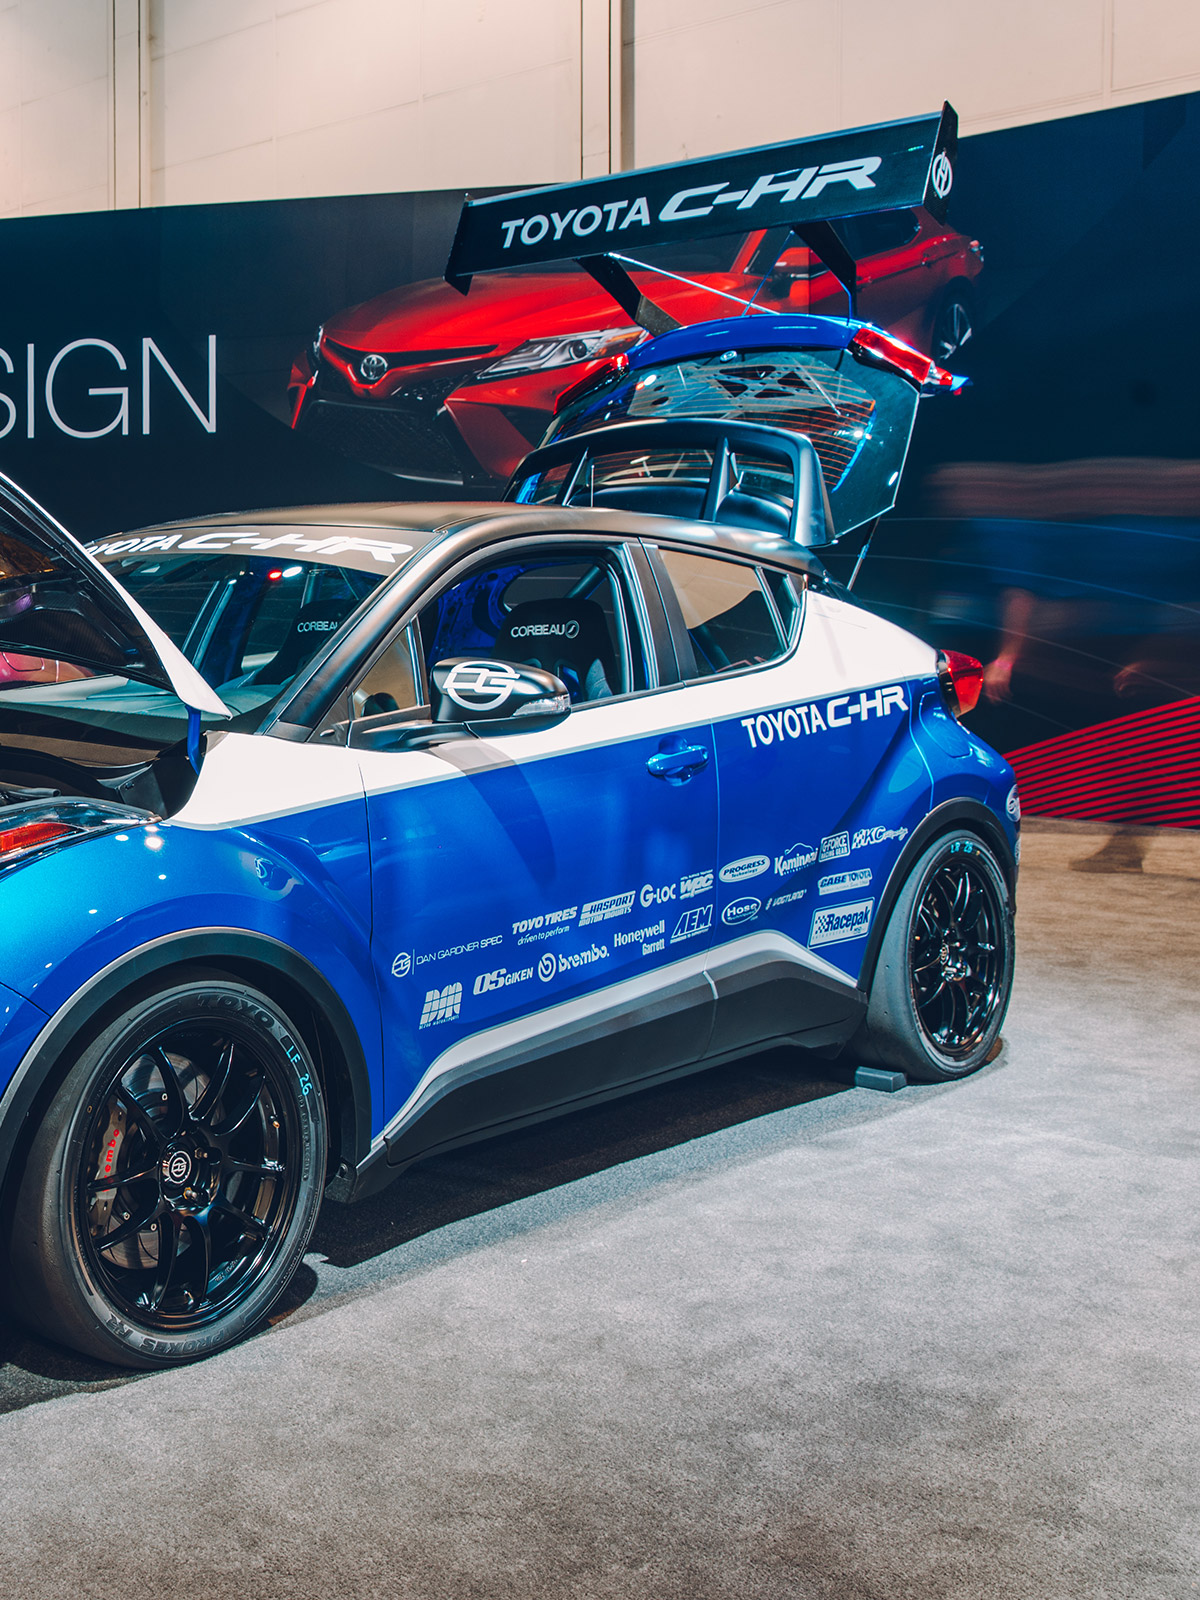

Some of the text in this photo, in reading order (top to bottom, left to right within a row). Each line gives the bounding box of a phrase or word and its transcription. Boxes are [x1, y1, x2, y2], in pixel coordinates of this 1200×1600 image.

[501, 156, 882, 249] TOYOTA C-HR
[86, 532, 413, 563] YOTA C-HR
[510, 623, 565, 638] CORBEAU
[740, 685, 909, 748] TOYOTA C-HR
[723, 859, 765, 875] PROGRESS
[589, 894, 635, 914] HASPORT
[512, 906, 578, 934] TOYO TIRES
[824, 906, 870, 932] Racepak
[517, 933, 538, 946] driven
[544, 925, 570, 940] perform
[614, 920, 665, 947] Honeywell
[642, 938, 665, 956] Garrett
[416, 935, 503, 965] DAN GARDNER SPEC
[473, 967, 534, 995] OS GIKEN
[286, 1045, 301, 1063] LF
[300, 1073, 312, 1096] 26
